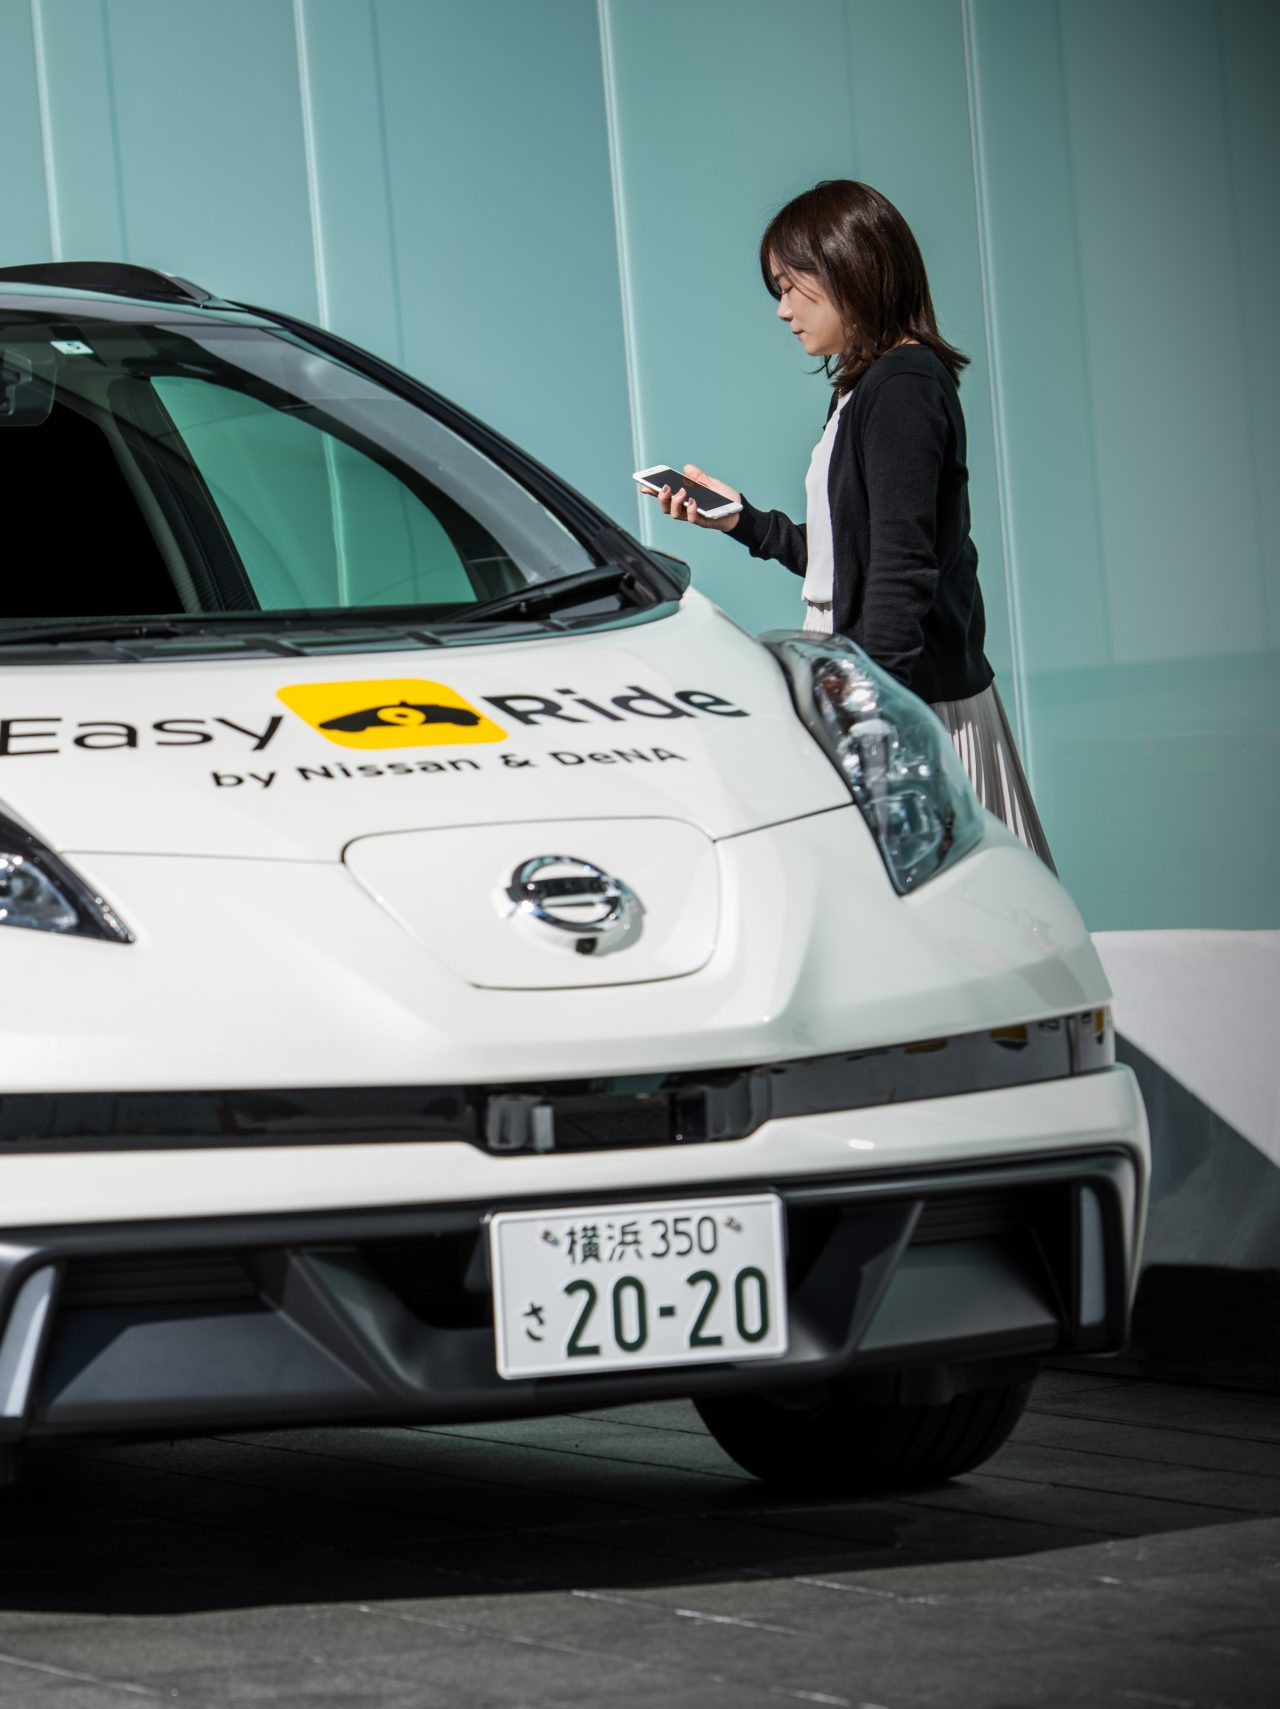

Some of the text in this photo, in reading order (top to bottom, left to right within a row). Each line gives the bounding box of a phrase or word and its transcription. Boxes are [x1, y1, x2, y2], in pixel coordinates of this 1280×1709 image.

[480, 685, 751, 726] Ride
[211, 746, 688, 789] by Nissan & DeNA
[523, 1266, 769, 1358] さ 20-20
